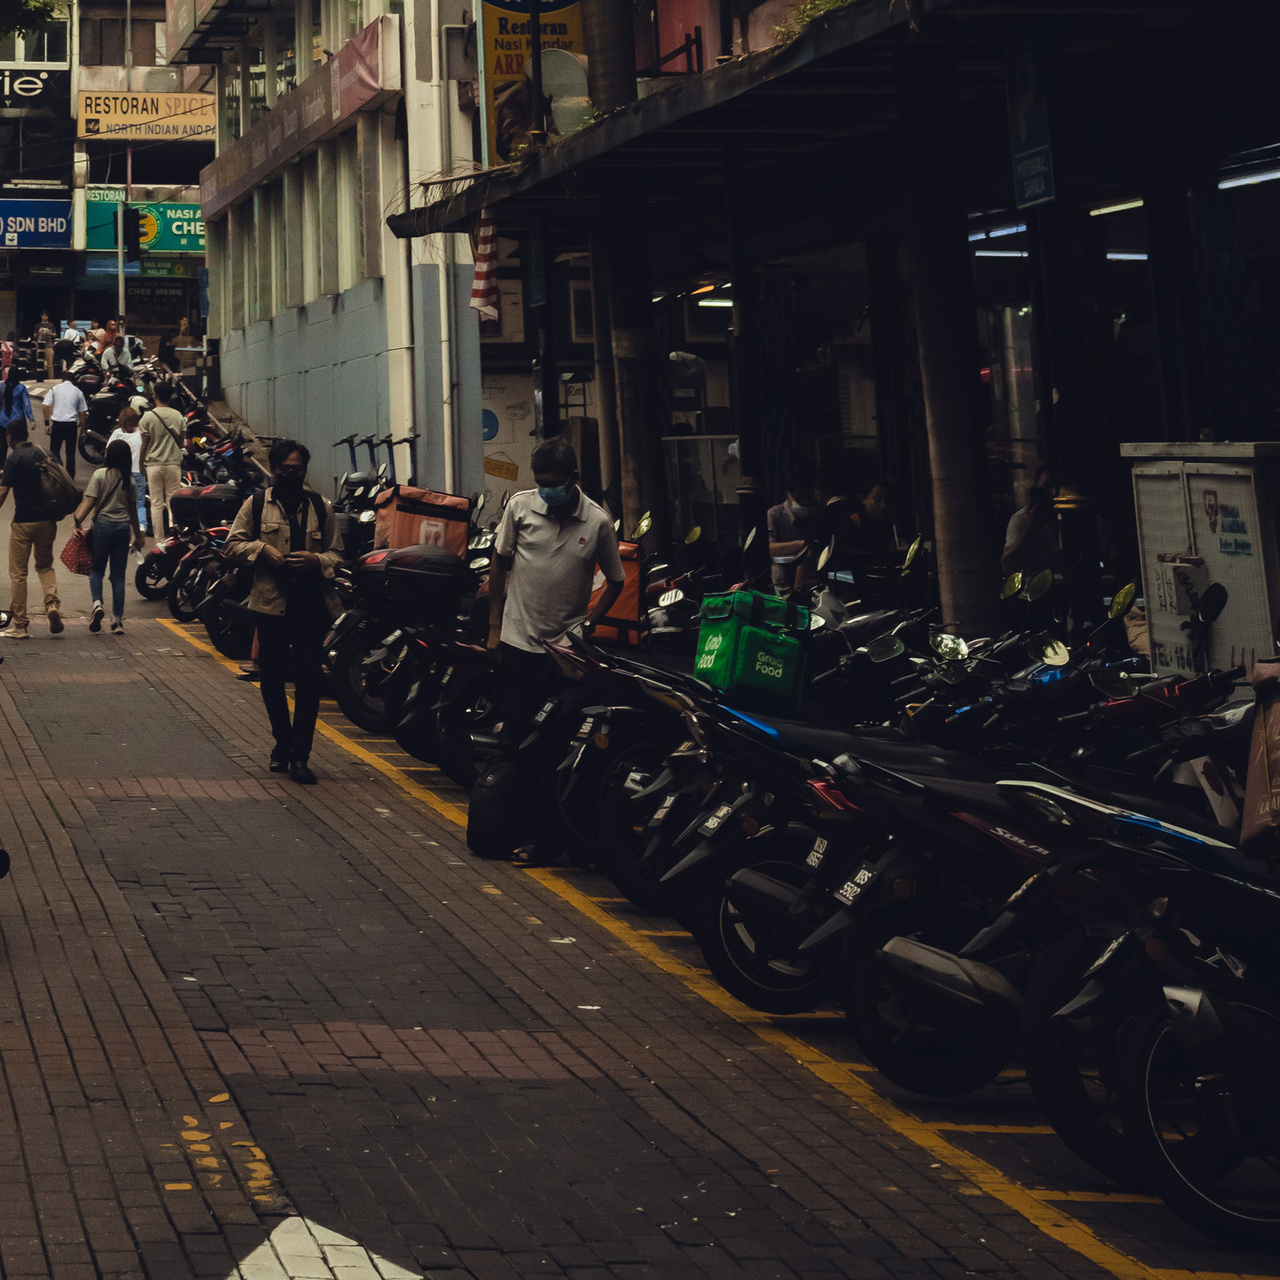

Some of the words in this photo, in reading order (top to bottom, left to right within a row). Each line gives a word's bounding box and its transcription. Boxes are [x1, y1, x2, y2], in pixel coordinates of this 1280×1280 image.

[497, 16, 568, 35] Restran
[494, 38, 522, 51] Nasi
[526, 38, 574, 51] Kndar
[85, 96, 160, 115] RESTORAN
[165, 97, 208, 116] SPICE
[106, 123, 142, 135] NORTH
[144, 124, 179, 136] INDIAN
[181, 124, 203, 136] AND
[86, 190, 126, 201] RESTORAN
[166, 209, 194, 219] NASI
[6, 217, 36, 233] SDN
[38, 217, 67, 233] BHD
[755, 661, 783, 678] Food
